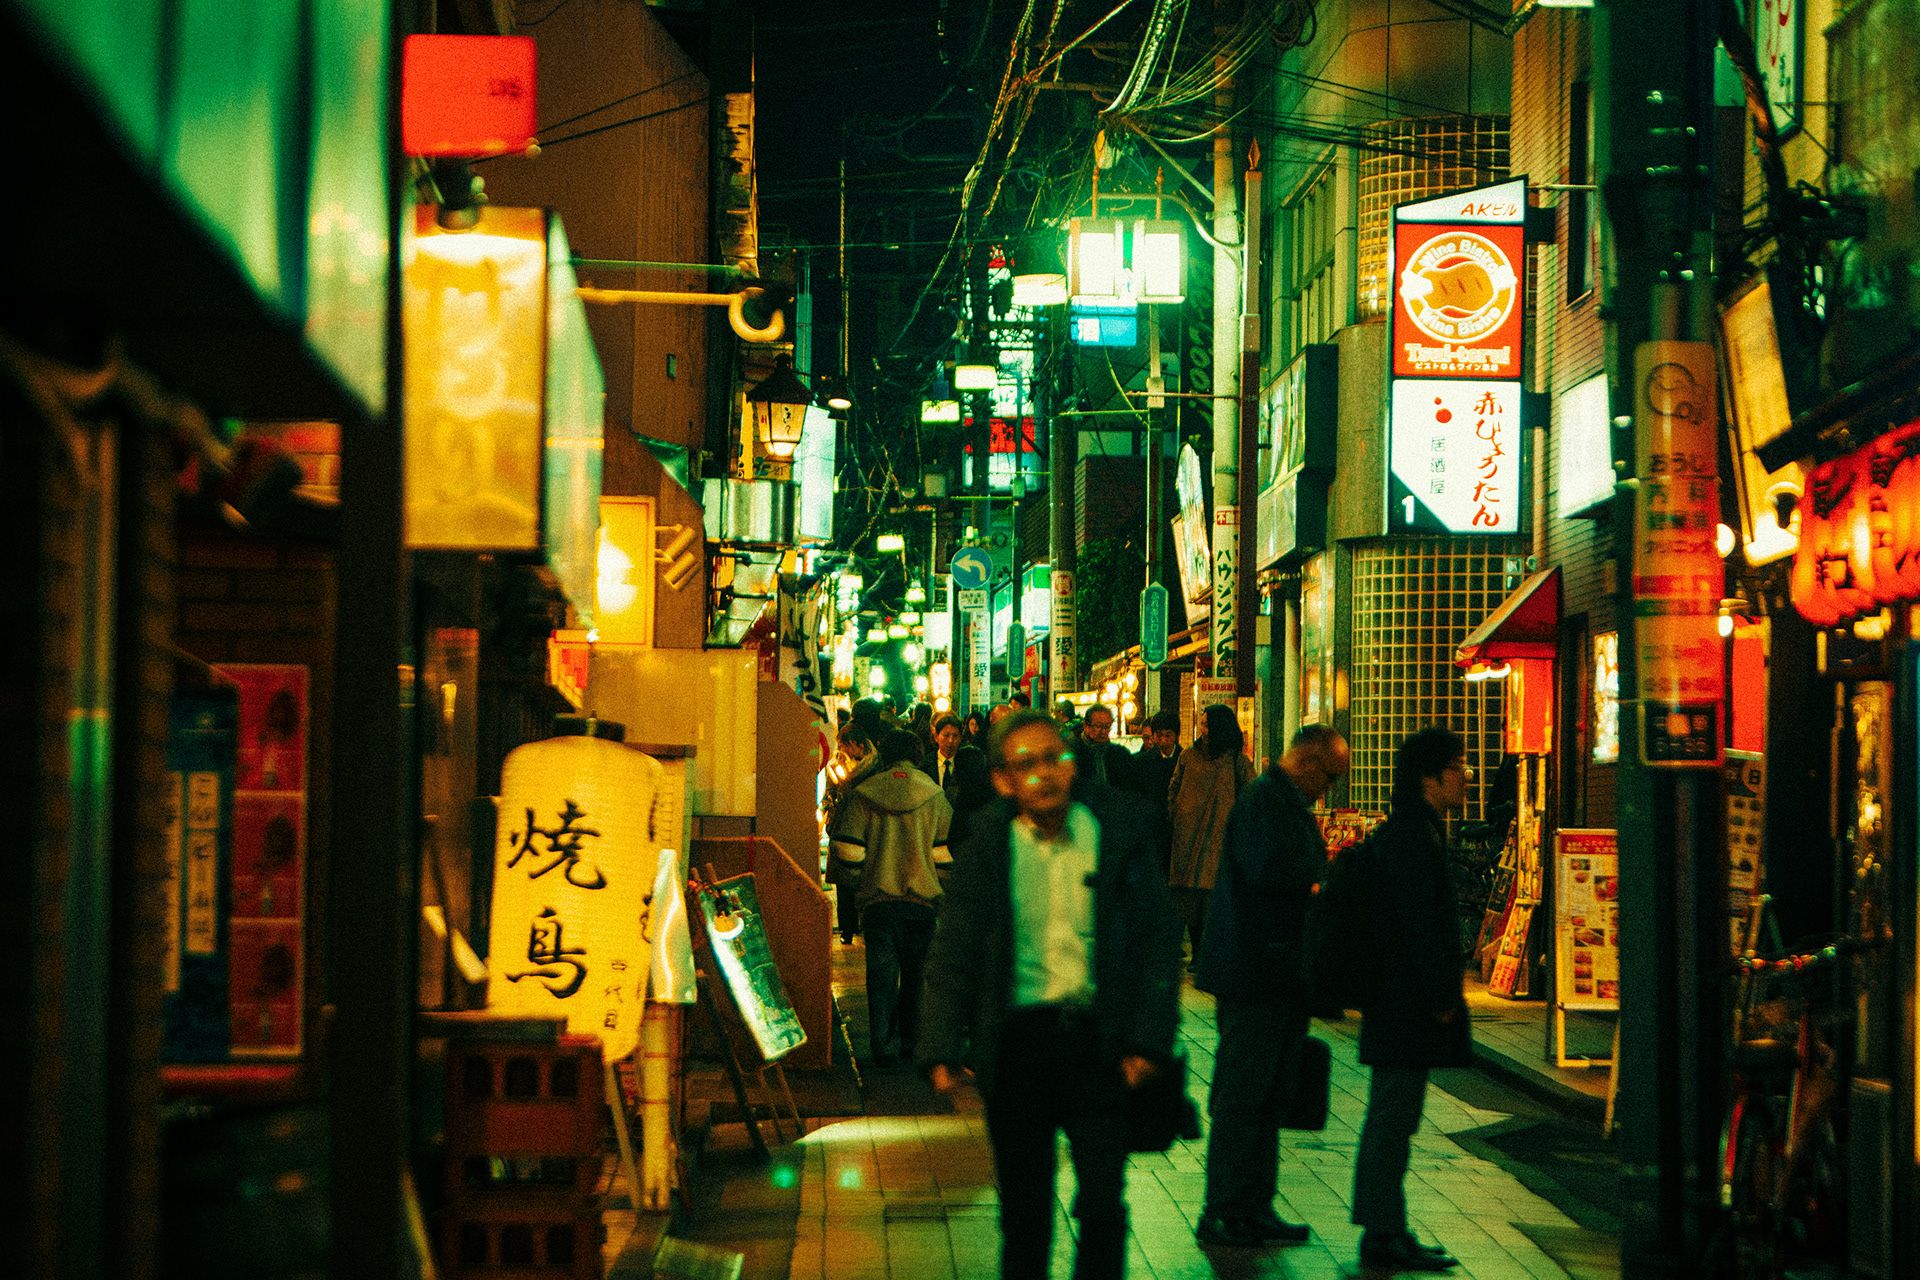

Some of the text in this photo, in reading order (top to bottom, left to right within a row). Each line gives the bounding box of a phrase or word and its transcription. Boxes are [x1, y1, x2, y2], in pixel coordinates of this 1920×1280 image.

[1460, 202, 1517, 217] AKビル
[1430, 436, 1446, 494] 居酒屋
[1472, 391, 1505, 527] 赤ひょうたん
[1401, 495, 1415, 525] 1
[506, 800, 607, 999] 焼鳥
